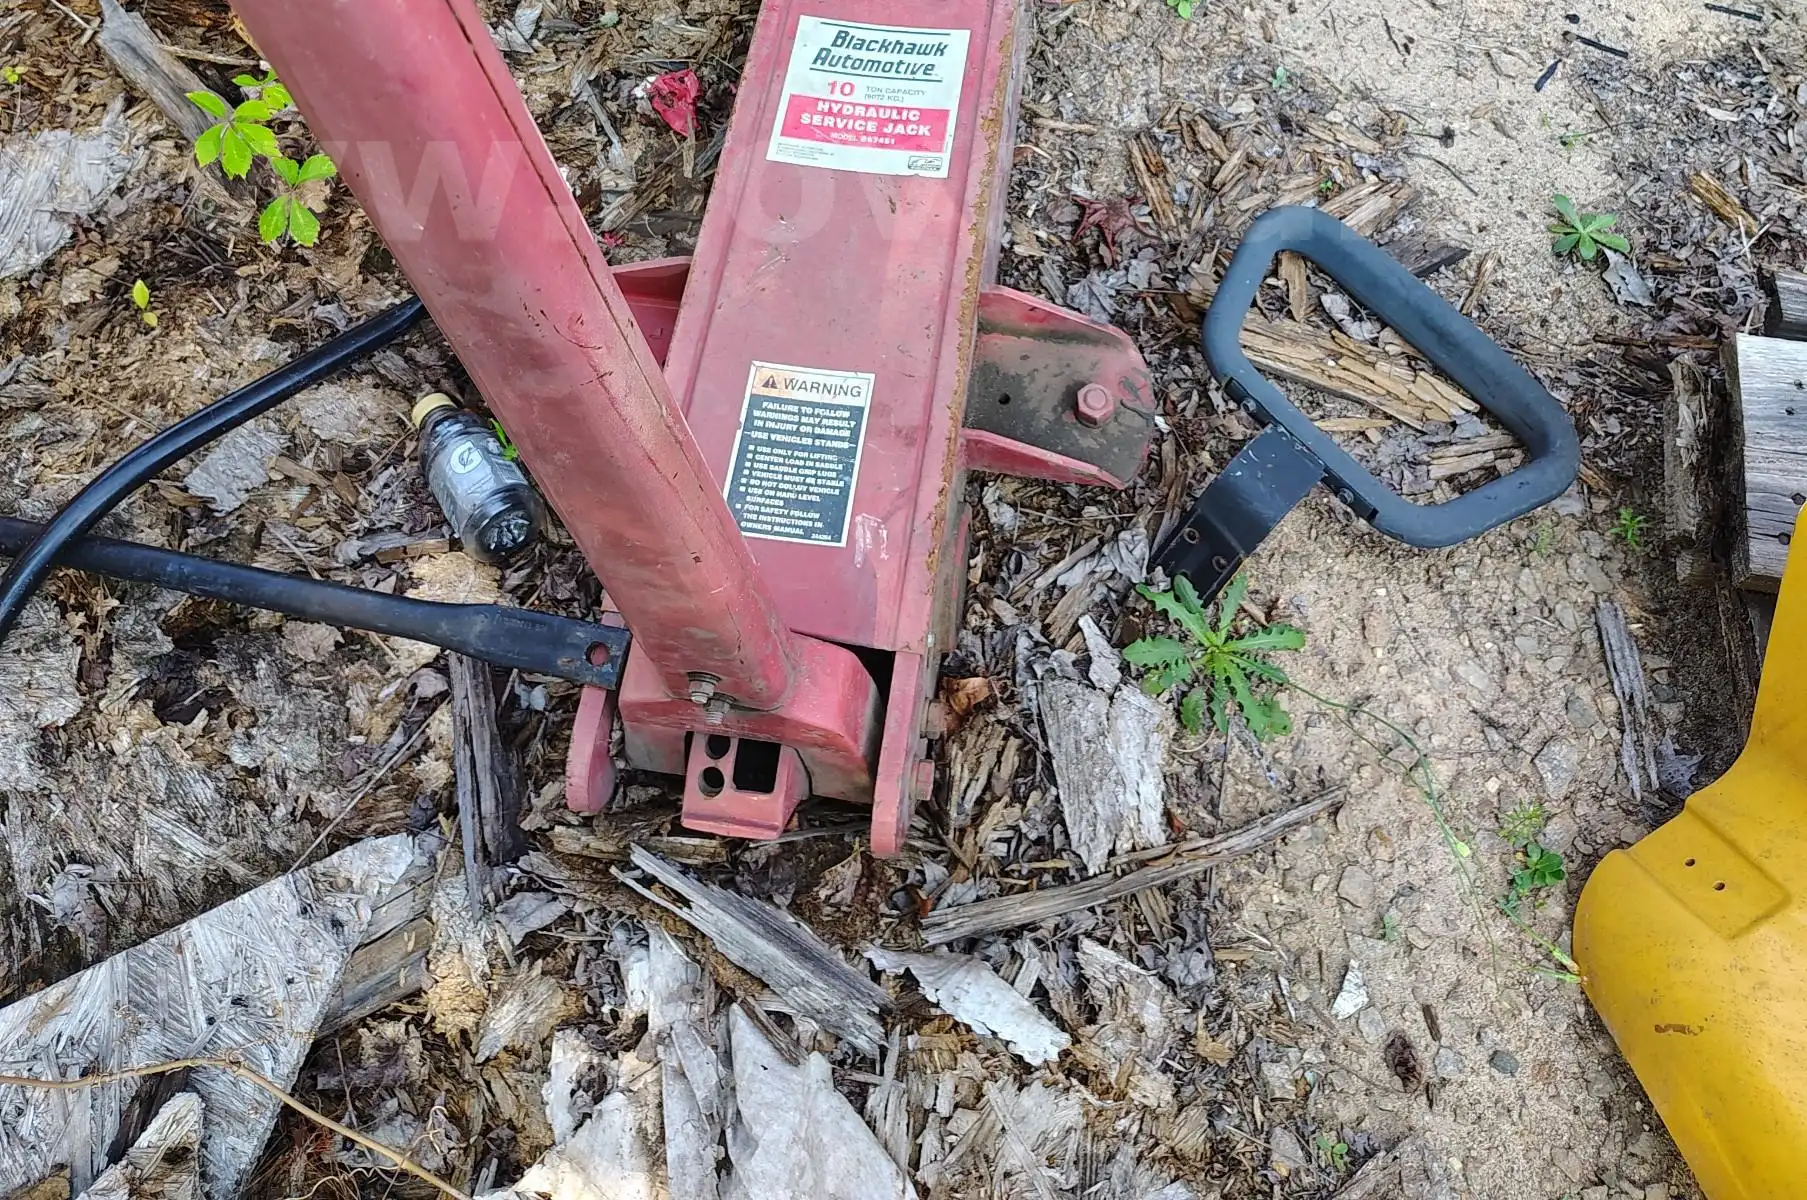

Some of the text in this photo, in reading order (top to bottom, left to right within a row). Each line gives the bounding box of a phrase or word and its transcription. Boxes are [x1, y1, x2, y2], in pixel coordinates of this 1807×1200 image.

[831, 30, 949, 57] Blackhawk
[811, 47, 936, 76] Automotive
[827, 80, 856, 97] 10
[866, 86, 927, 96] TON CAPACITY
[816, 100, 921, 121] HYDRAULIC
[800, 113, 932, 137] SERVICE JACK
[830, 131, 859, 143] MODEL
[783, 377, 862, 398] WARNING
[762, 401, 799, 413] FAILURE
[814, 408, 850, 418] FOLLOW
[753, 409, 857, 428] WARNINGS MAY RESULT
[753, 419, 763, 427] IN
[765, 420, 799, 432] INJURY
[814, 427, 851, 437] DAMAGE
[756, 445, 838, 461] USE ONLY FOR LIFTING
[755, 454, 784, 464] CENTER
[815, 461, 843, 470] SADDLE
[752, 470, 783, 480] VEHICLE
[783, 475, 805, 483] MUST
[761, 480, 778, 488] NOT
[747, 486, 763, 494] USE
[798, 494, 821, 502] LEVEL
[744, 503, 820, 519] FOR SAFETY FOLLOW
[759, 514, 813, 527] INSTRUCTIONS
[773, 525, 804, 535] MANUAL
